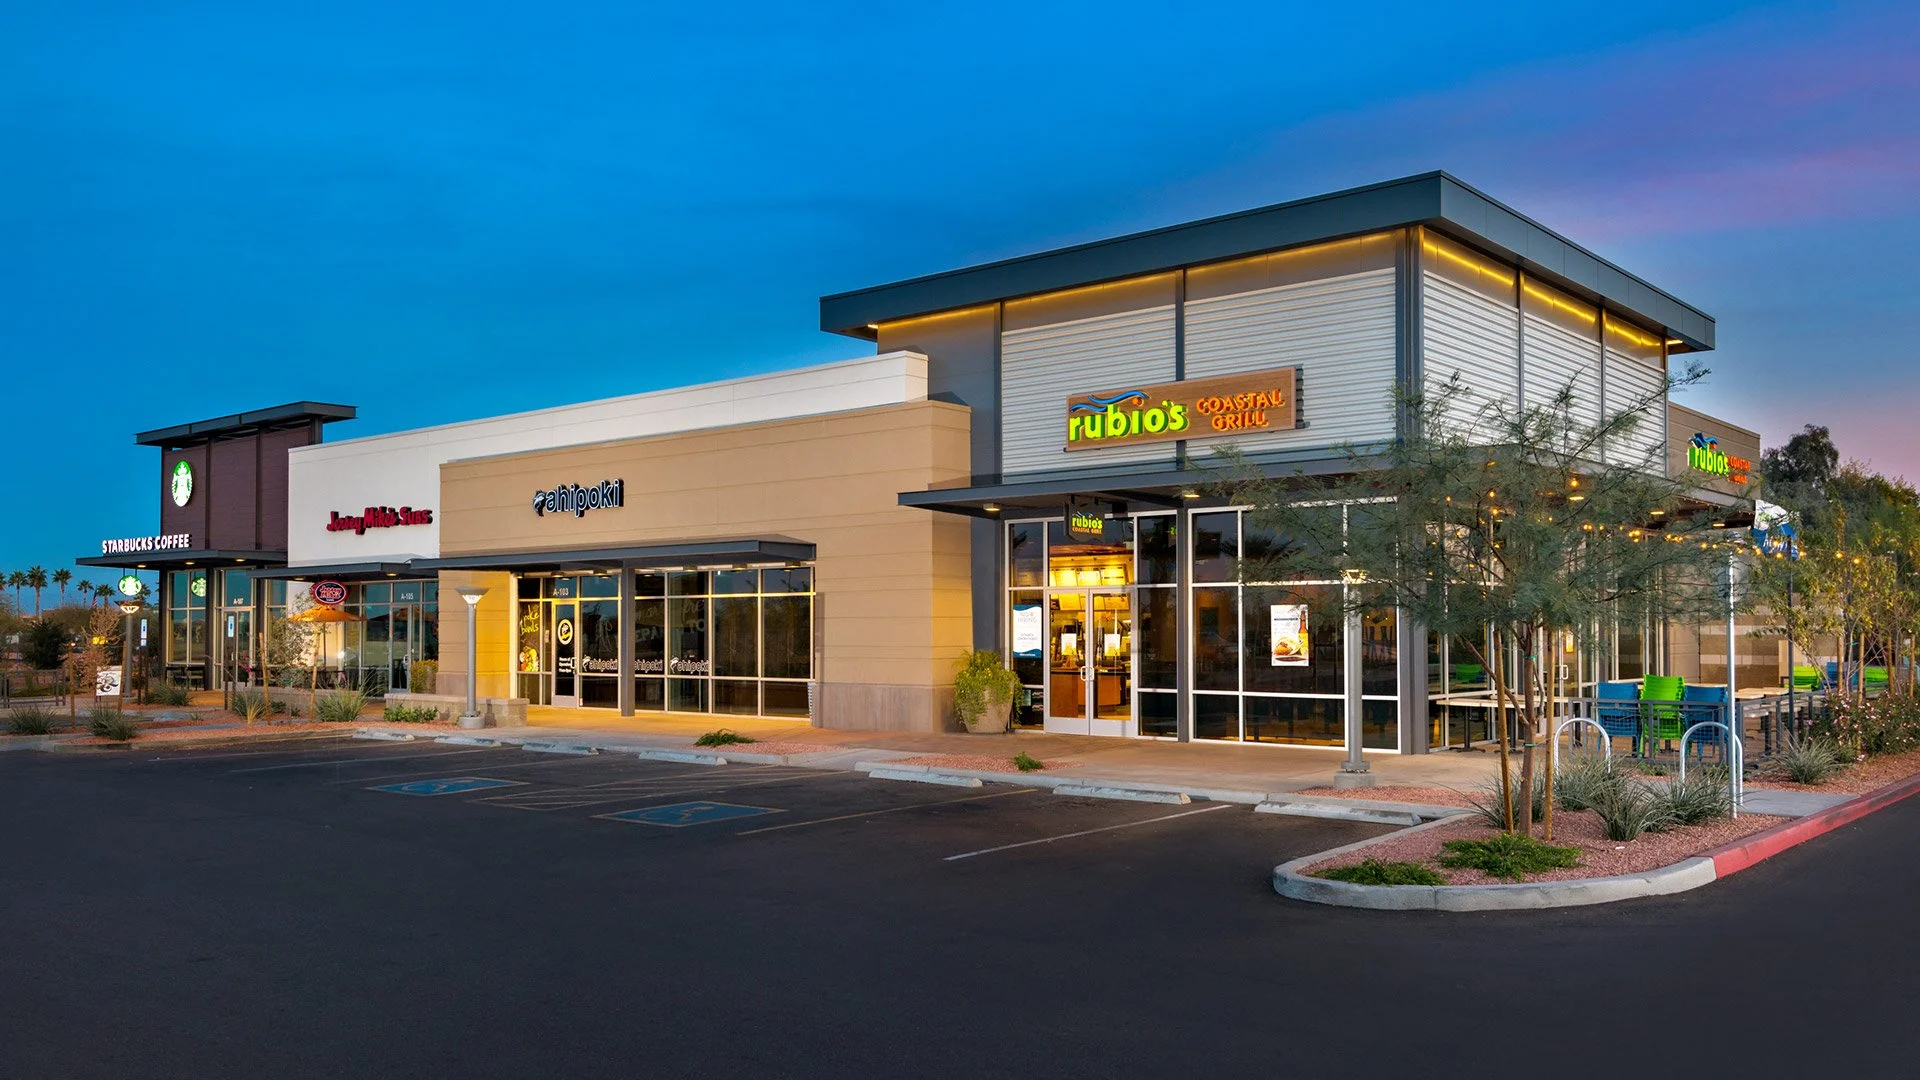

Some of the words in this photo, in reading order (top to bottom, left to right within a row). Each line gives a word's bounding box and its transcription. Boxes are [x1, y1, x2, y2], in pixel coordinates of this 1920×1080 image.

[1196, 388, 1285, 416] COASTAL
[1068, 397, 1189, 441] rubio's
[1211, 409, 1268, 432] GRILL
[1689, 443, 1730, 477] rubio's
[545, 479, 623, 517] ahipoki
[326, 511, 364, 535] Jersey
[363, 506, 398, 528] Mike's
[1071, 515, 1103, 530] rubio's
[102, 536, 153, 554] STARBUCKS
[154, 533, 191, 550] COFFEE
